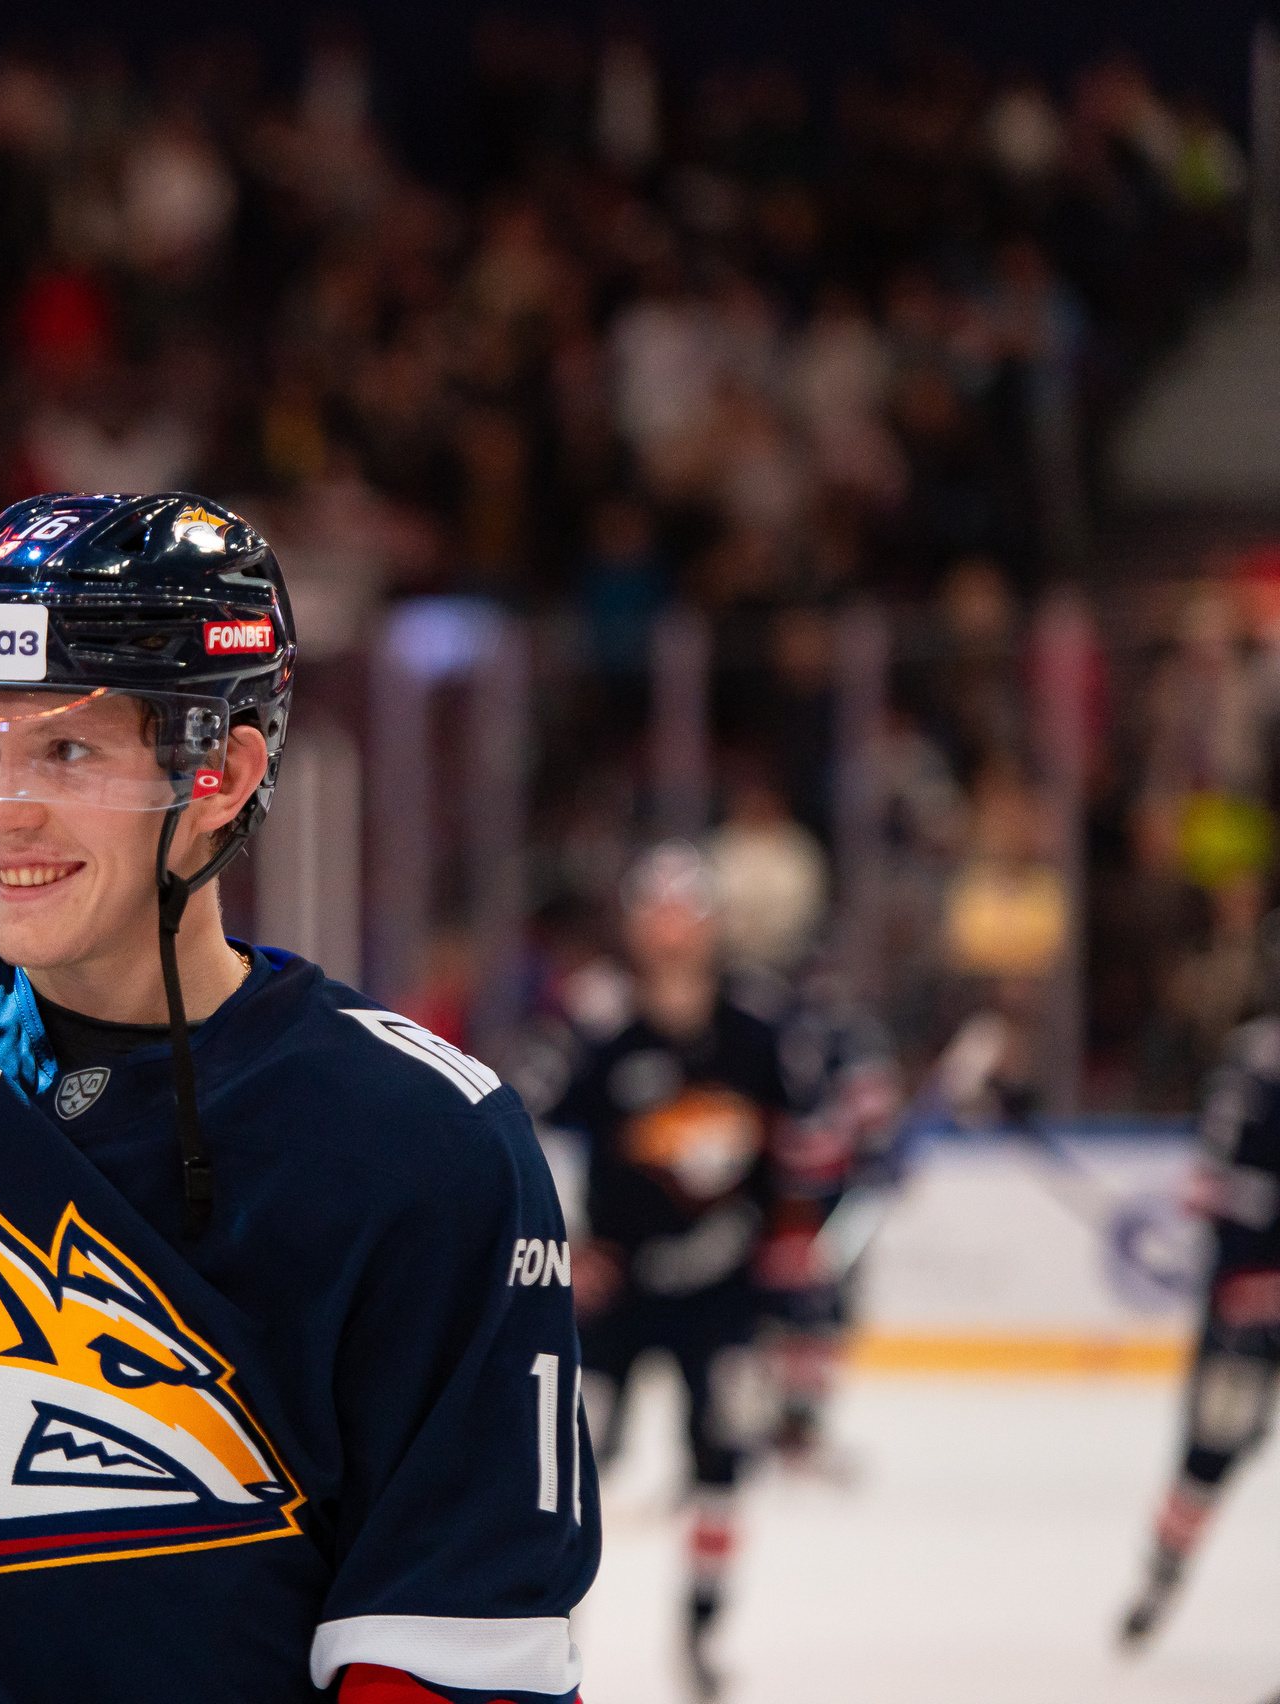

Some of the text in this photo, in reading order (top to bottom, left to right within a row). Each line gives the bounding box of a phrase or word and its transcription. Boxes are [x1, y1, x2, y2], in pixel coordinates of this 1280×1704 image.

[16, 516, 80, 540] 16
[209, 626, 271, 649] FONBET
[508, 1238, 571, 1287] FON
[529, 1353, 582, 1527] 1
